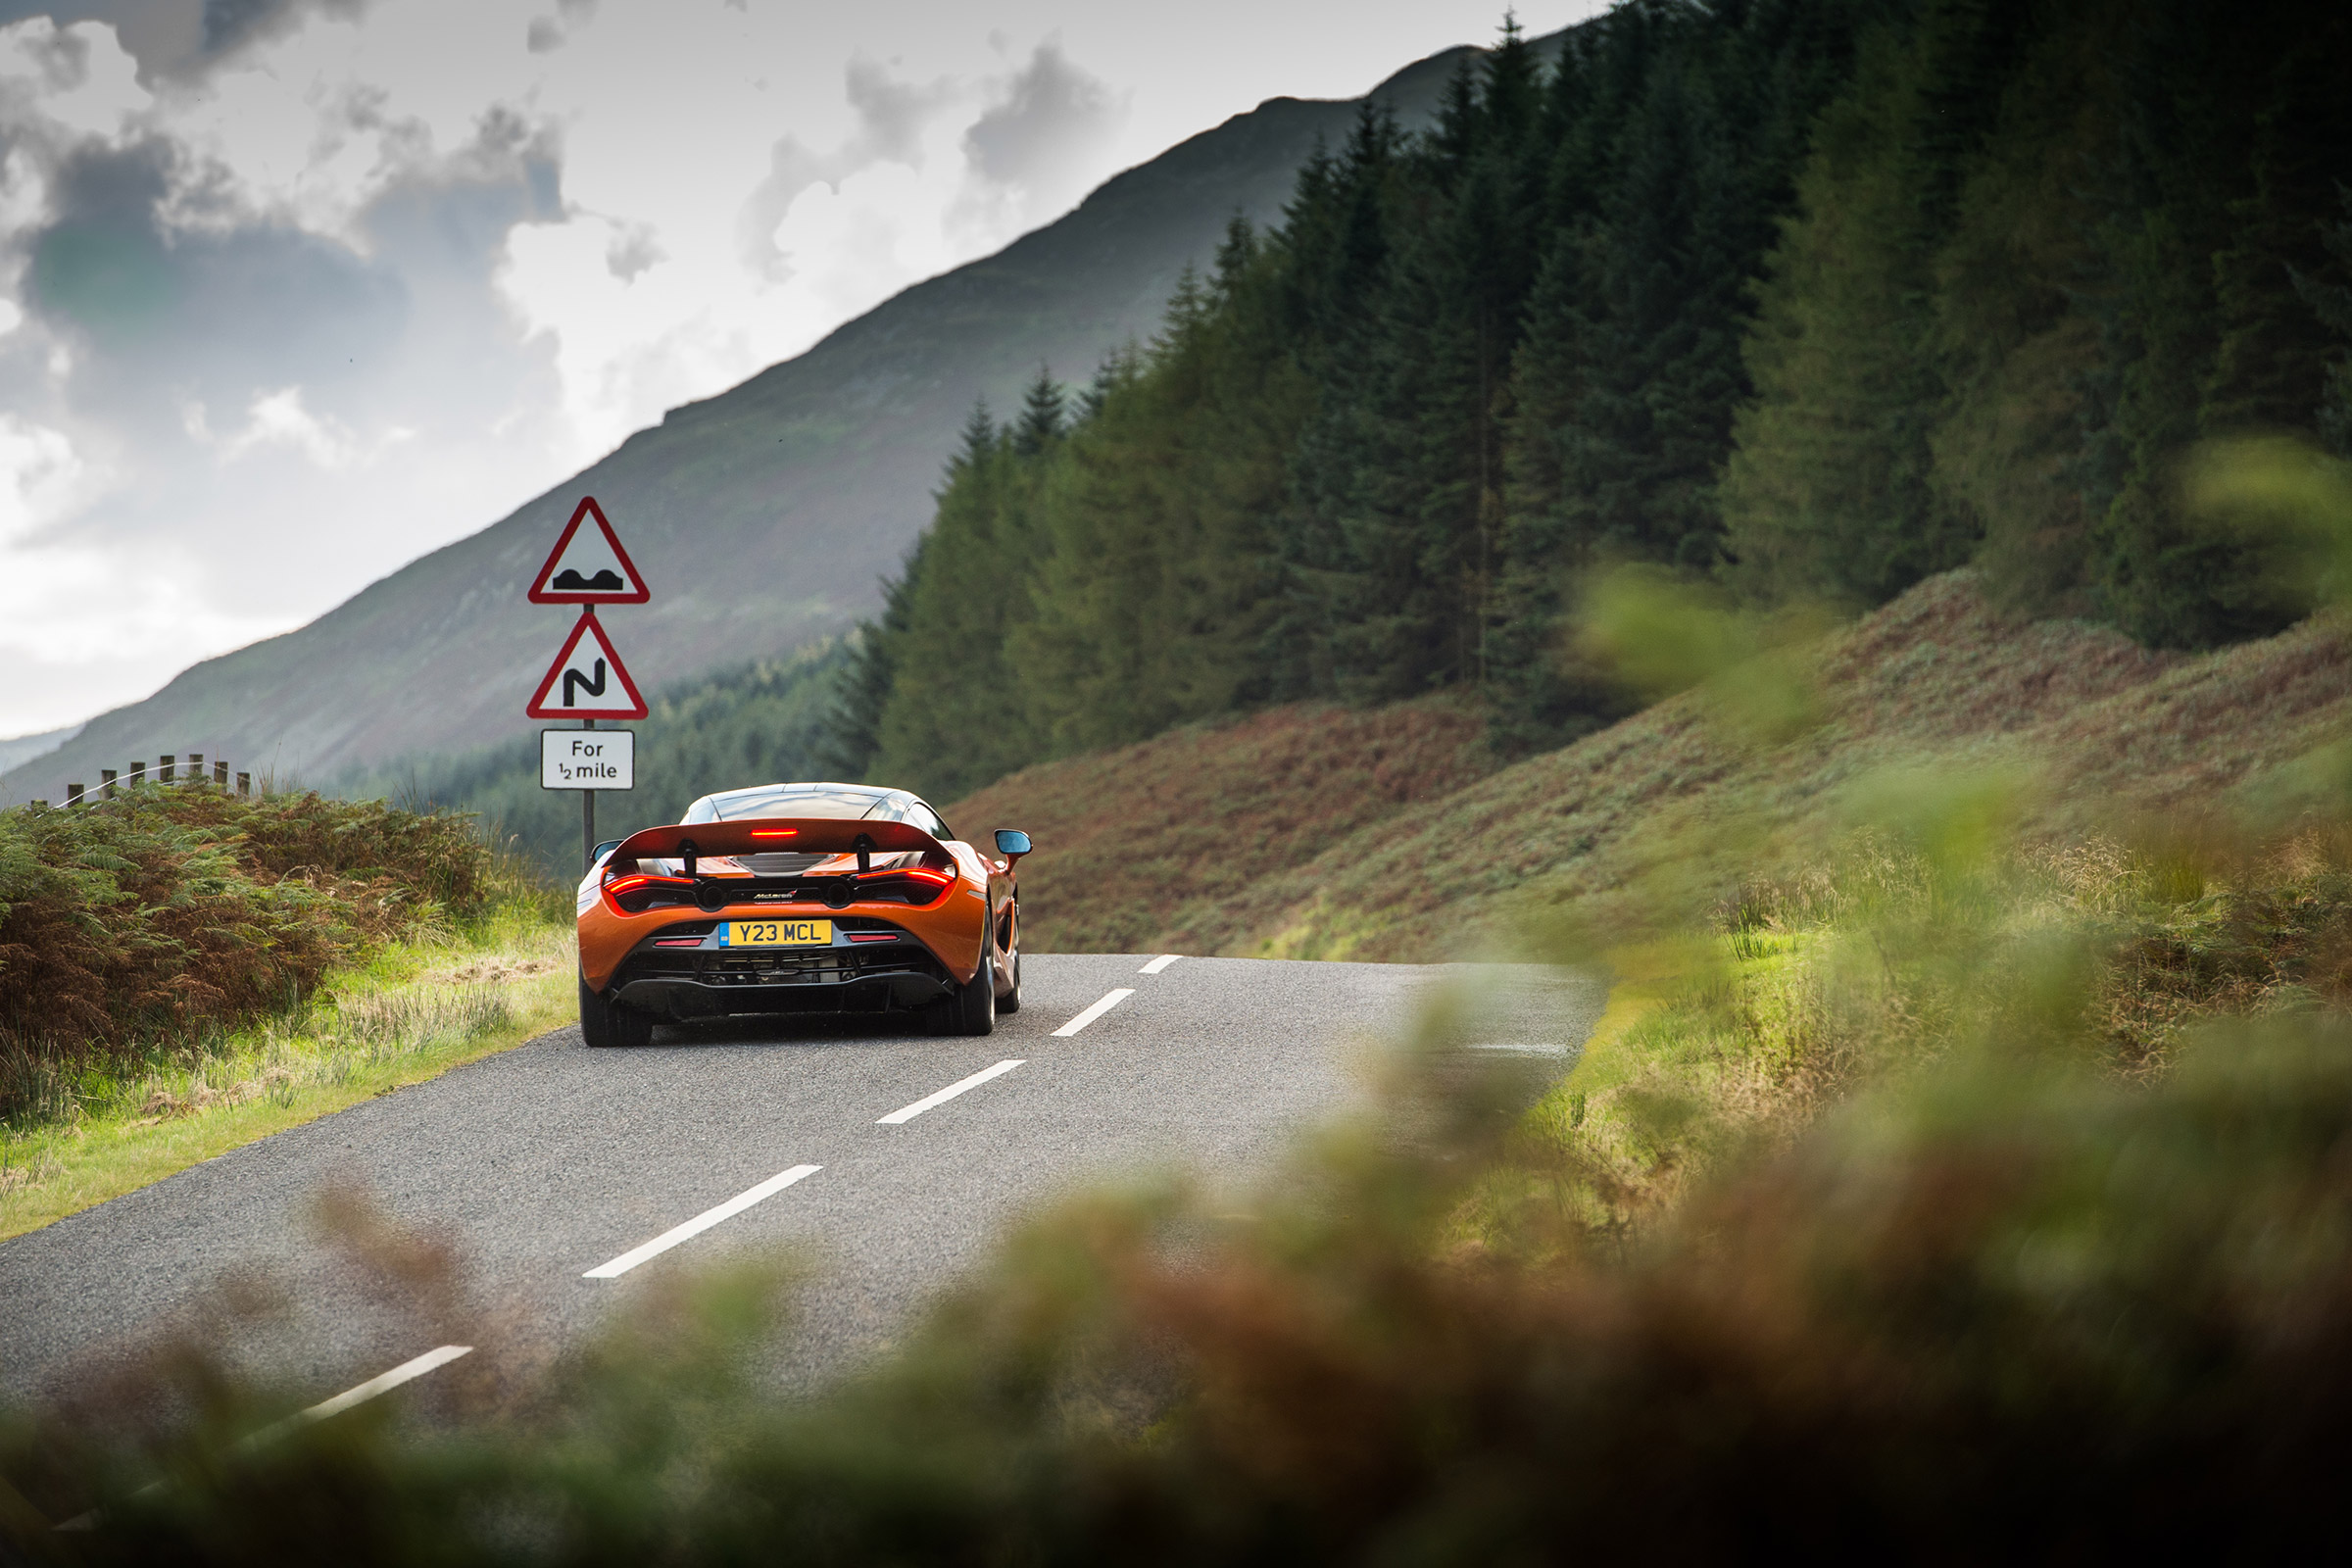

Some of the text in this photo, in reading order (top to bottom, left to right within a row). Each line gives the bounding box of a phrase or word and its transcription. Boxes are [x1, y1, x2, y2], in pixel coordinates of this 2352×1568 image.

[572, 740, 604, 757] For
[576, 762, 617, 778] mile
[740, 923, 821, 942] Y23 MCL
